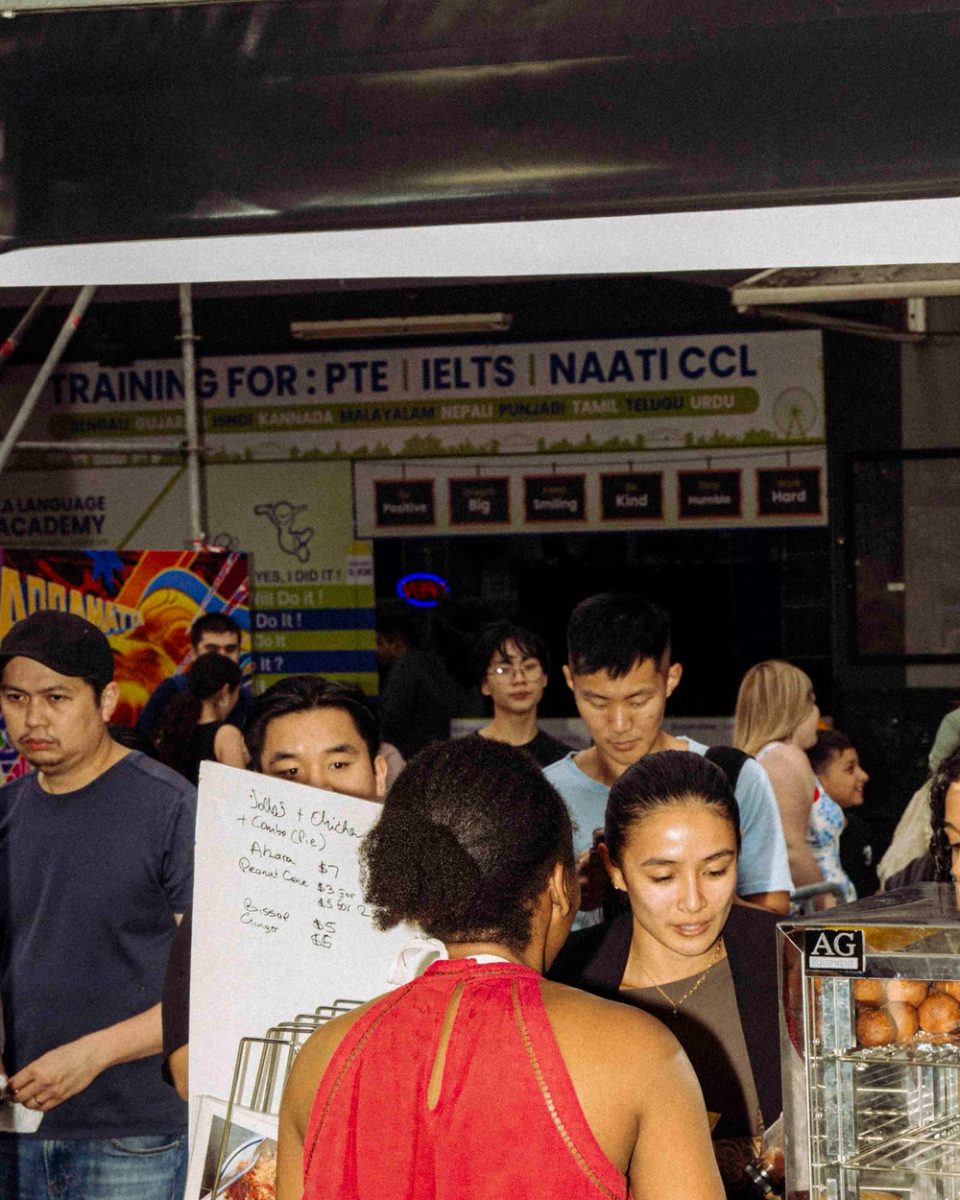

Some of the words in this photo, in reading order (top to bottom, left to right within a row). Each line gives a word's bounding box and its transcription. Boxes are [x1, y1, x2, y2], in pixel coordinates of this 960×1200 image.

[51, 368, 217, 404] TRAINING
[326, 360, 388, 393] PTE
[421, 355, 514, 390] IELTS
[550, 348, 668, 384] NAATI
[679, 345, 757, 378] CCL
[258, 409, 333, 426] KANNADA
[340, 406, 436, 422] MALAYALAM
[441, 404, 493, 419] NEPALI
[499, 401, 565, 417] PUNJABI
[572, 398, 618, 414] TAMIL
[626, 395, 684, 412] TELUGU
[690, 394, 735, 409] URDU
[19, 496, 105, 512] LANGUAGE
[615, 492, 649, 508] Kind
[687, 494, 732, 506] Humble
[771, 489, 807, 503] Hard
[468, 497, 491, 515] Big
[532, 497, 578, 513] Smiling
[0, 515, 105, 536] ACADEMY
[295, 569, 318, 583] DID
[277, 591, 299, 606] Do
[255, 613, 278, 629] Do
[251, 815, 287, 837] Combo
[318, 860, 340, 879] $7
[312, 918, 337, 934] $5
[811, 932, 856, 956] AG
